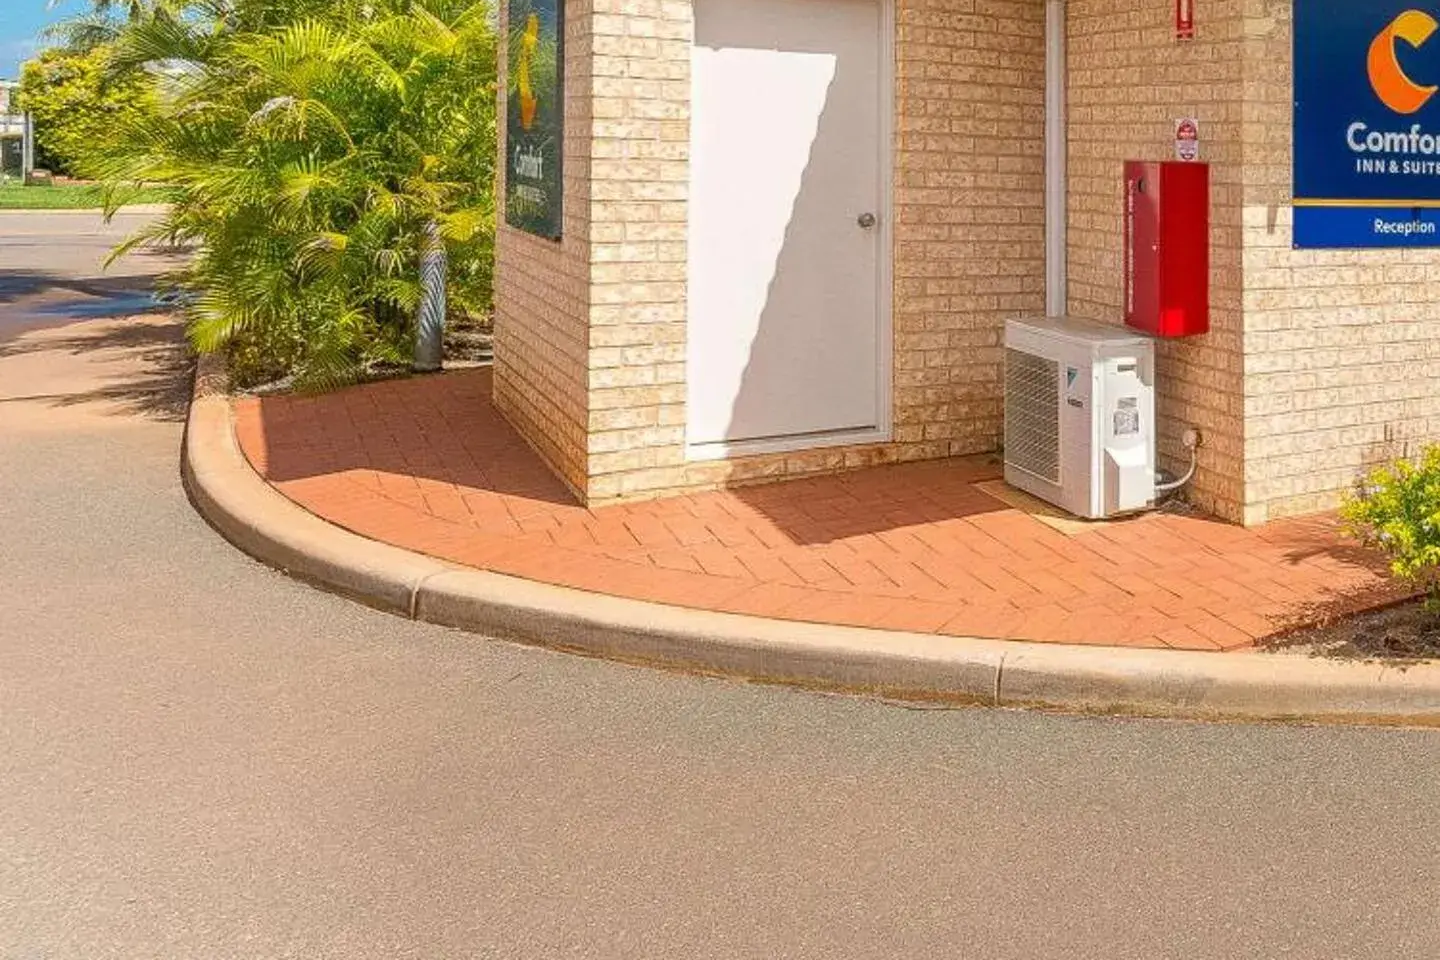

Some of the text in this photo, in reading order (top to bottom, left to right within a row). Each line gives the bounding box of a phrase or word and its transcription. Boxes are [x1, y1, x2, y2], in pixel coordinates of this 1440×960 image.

[1356, 159, 1386, 174] INN
[1388, 159, 1400, 174] &
[1374, 217, 1436, 237] Reception
